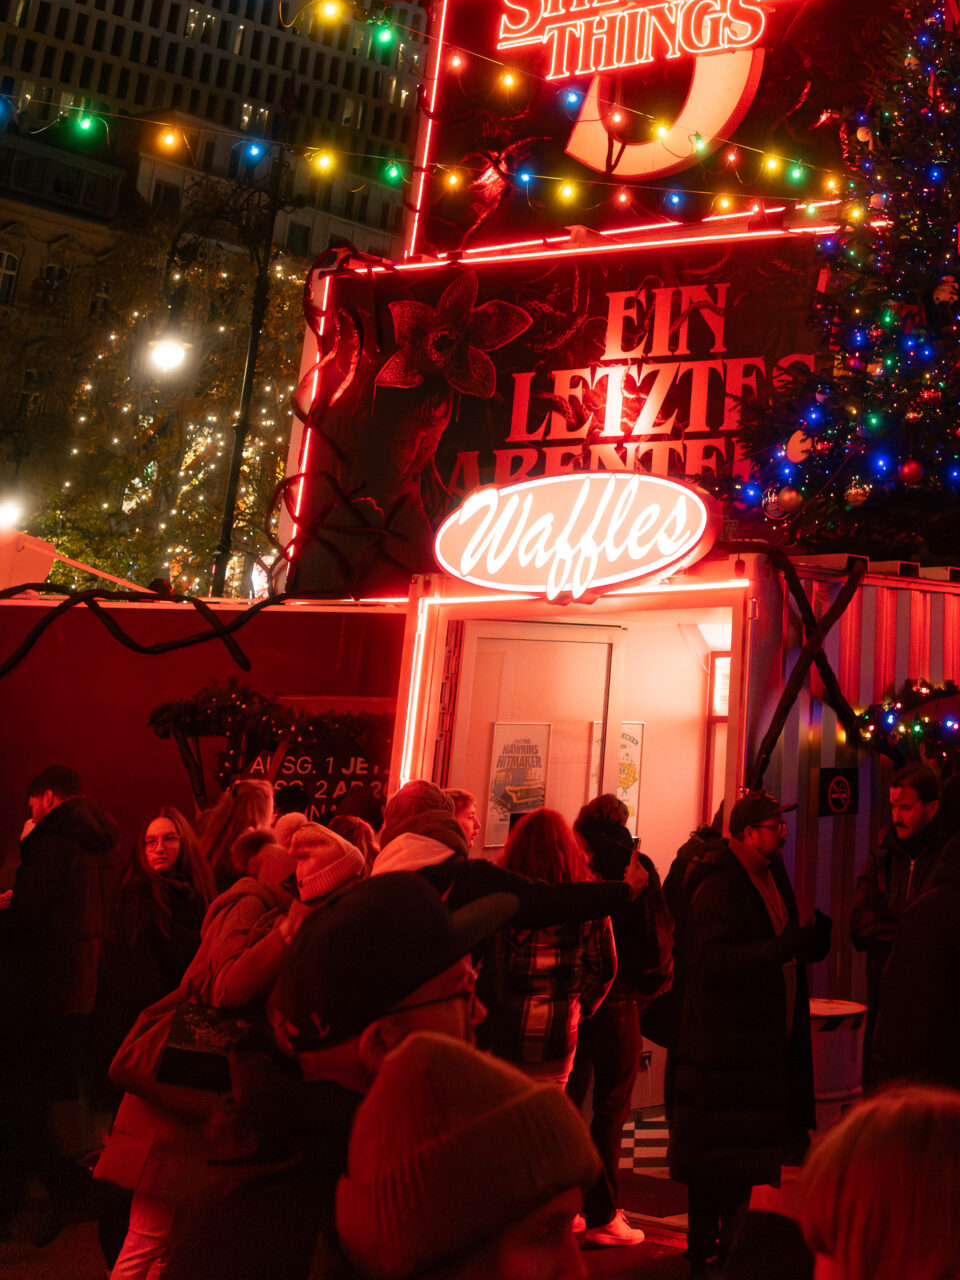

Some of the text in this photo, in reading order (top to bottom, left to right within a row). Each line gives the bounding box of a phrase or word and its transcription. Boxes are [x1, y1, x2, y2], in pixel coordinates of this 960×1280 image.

[602, 284, 730, 361] EIN
[459, 472, 691, 602] Waffles
[496, 755, 542, 768] HITMAKER
